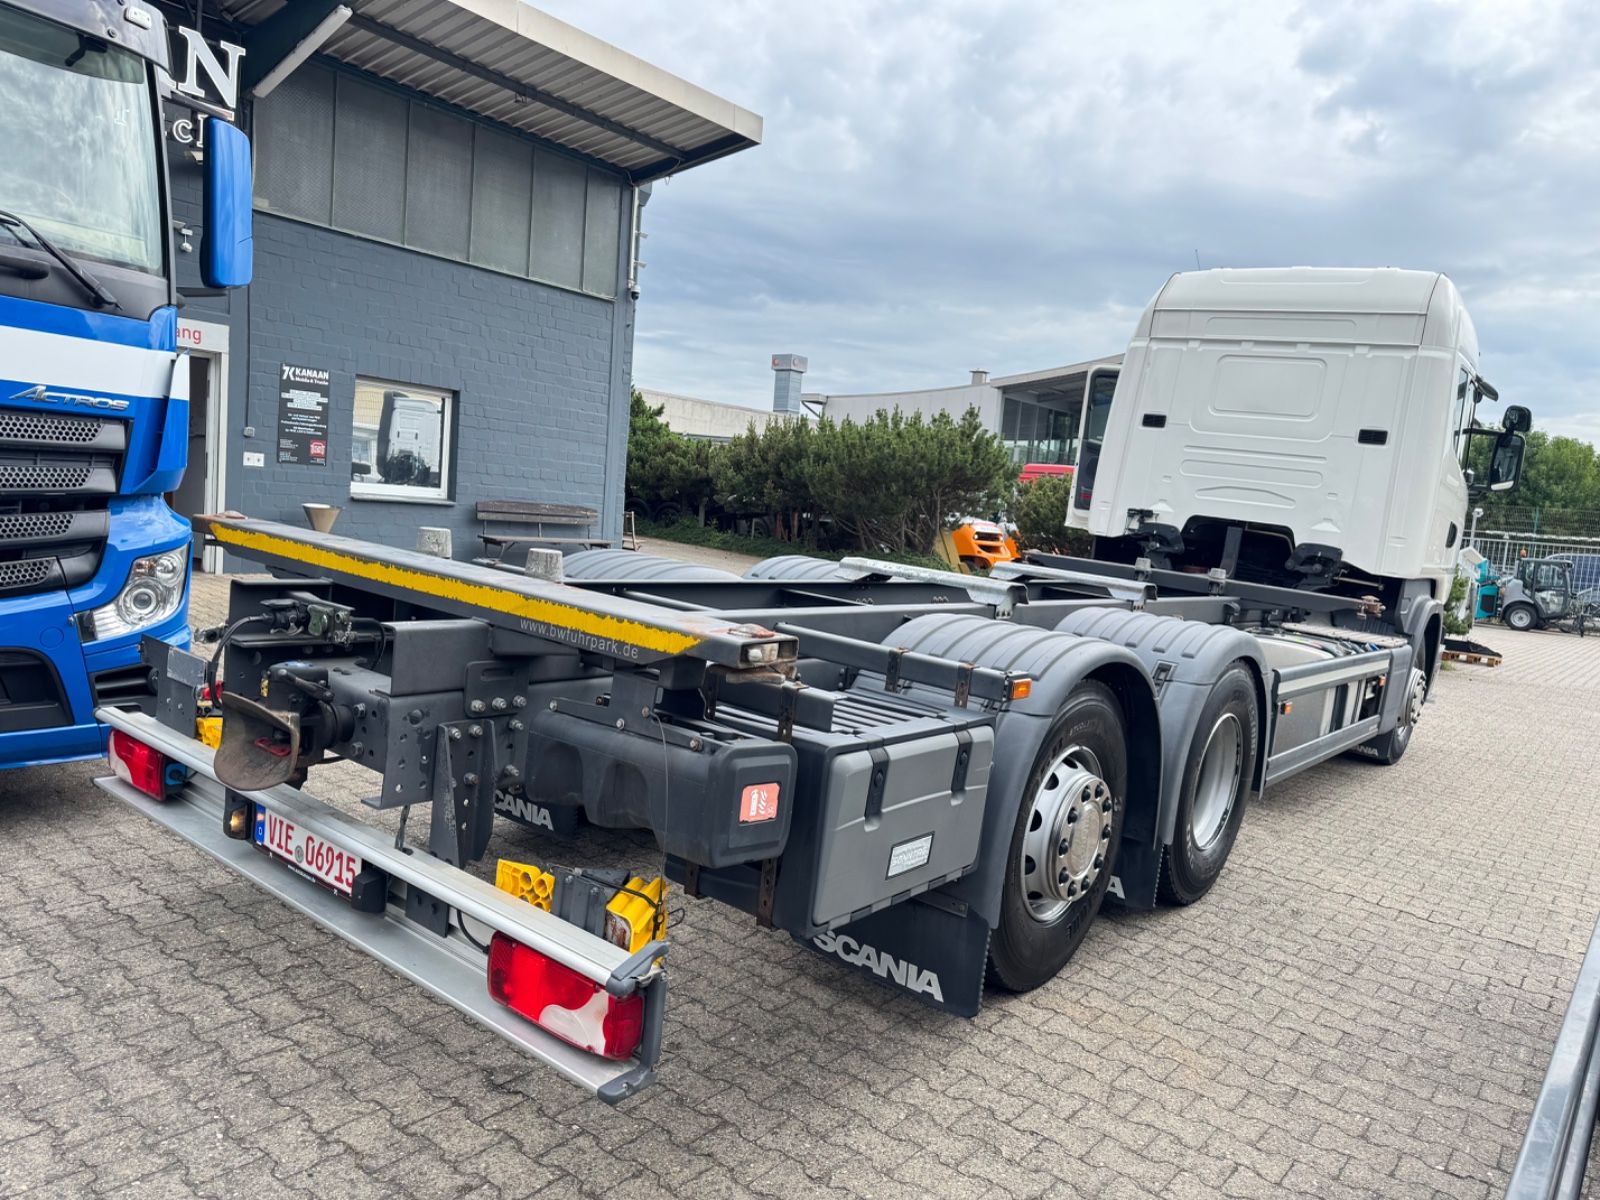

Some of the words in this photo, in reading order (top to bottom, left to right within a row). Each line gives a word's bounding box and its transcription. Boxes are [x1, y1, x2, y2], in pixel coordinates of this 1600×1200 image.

[160, 25, 246, 109] N
[295, 367, 329, 380] KANAAN
[494, 789, 554, 831] CANIA
[268, 814, 295, 856] VIE
[305, 835, 356, 888] 06915
[813, 930, 945, 1003] SCANIA
